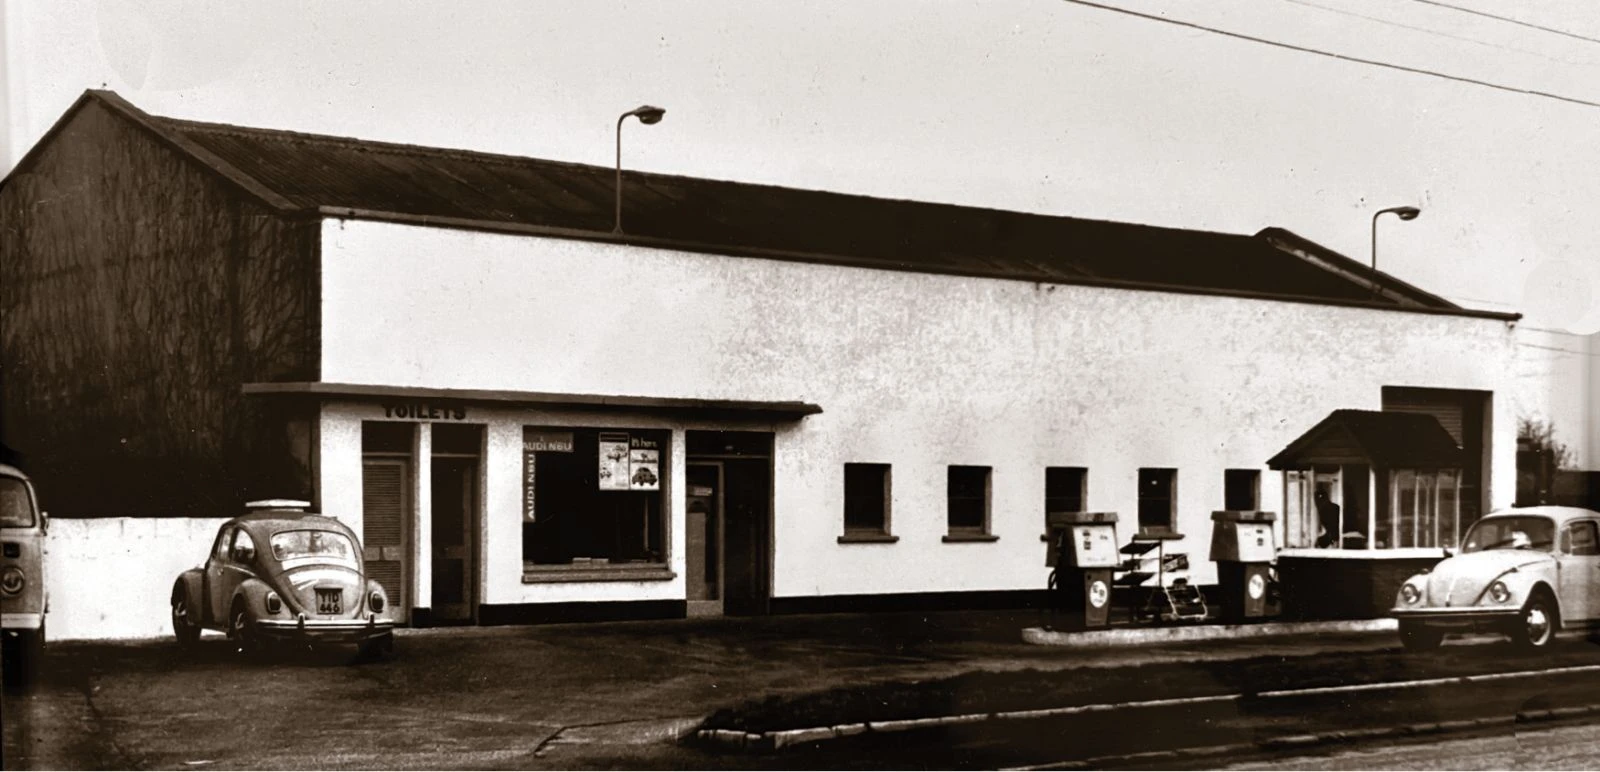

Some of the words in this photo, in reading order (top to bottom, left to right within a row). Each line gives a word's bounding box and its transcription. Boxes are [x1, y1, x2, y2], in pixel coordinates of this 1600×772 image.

[381, 404, 466, 420] TOILETS
[522, 441, 547, 450] AUDI
[527, 485, 535, 520] AUDI
